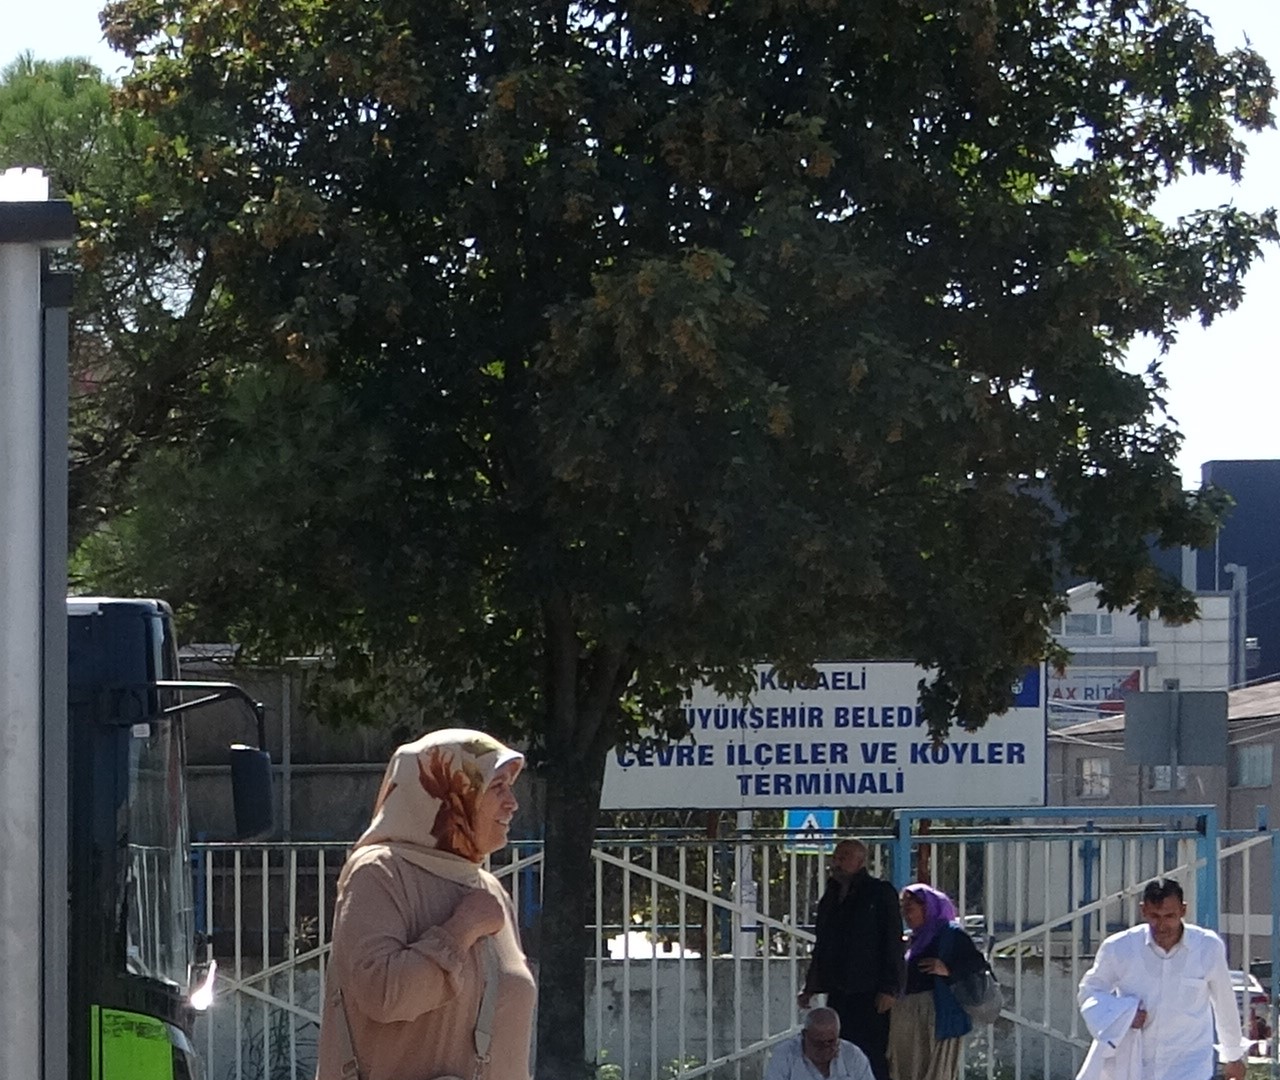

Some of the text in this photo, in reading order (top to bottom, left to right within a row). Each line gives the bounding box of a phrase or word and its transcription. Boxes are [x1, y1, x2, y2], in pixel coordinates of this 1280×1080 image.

[682, 701, 824, 734] ÜYÜKŞEHİR
[726, 739, 849, 772] İLÇELER
[862, 742, 898, 765] VE
[736, 767, 905, 796] TERMİNALİ
